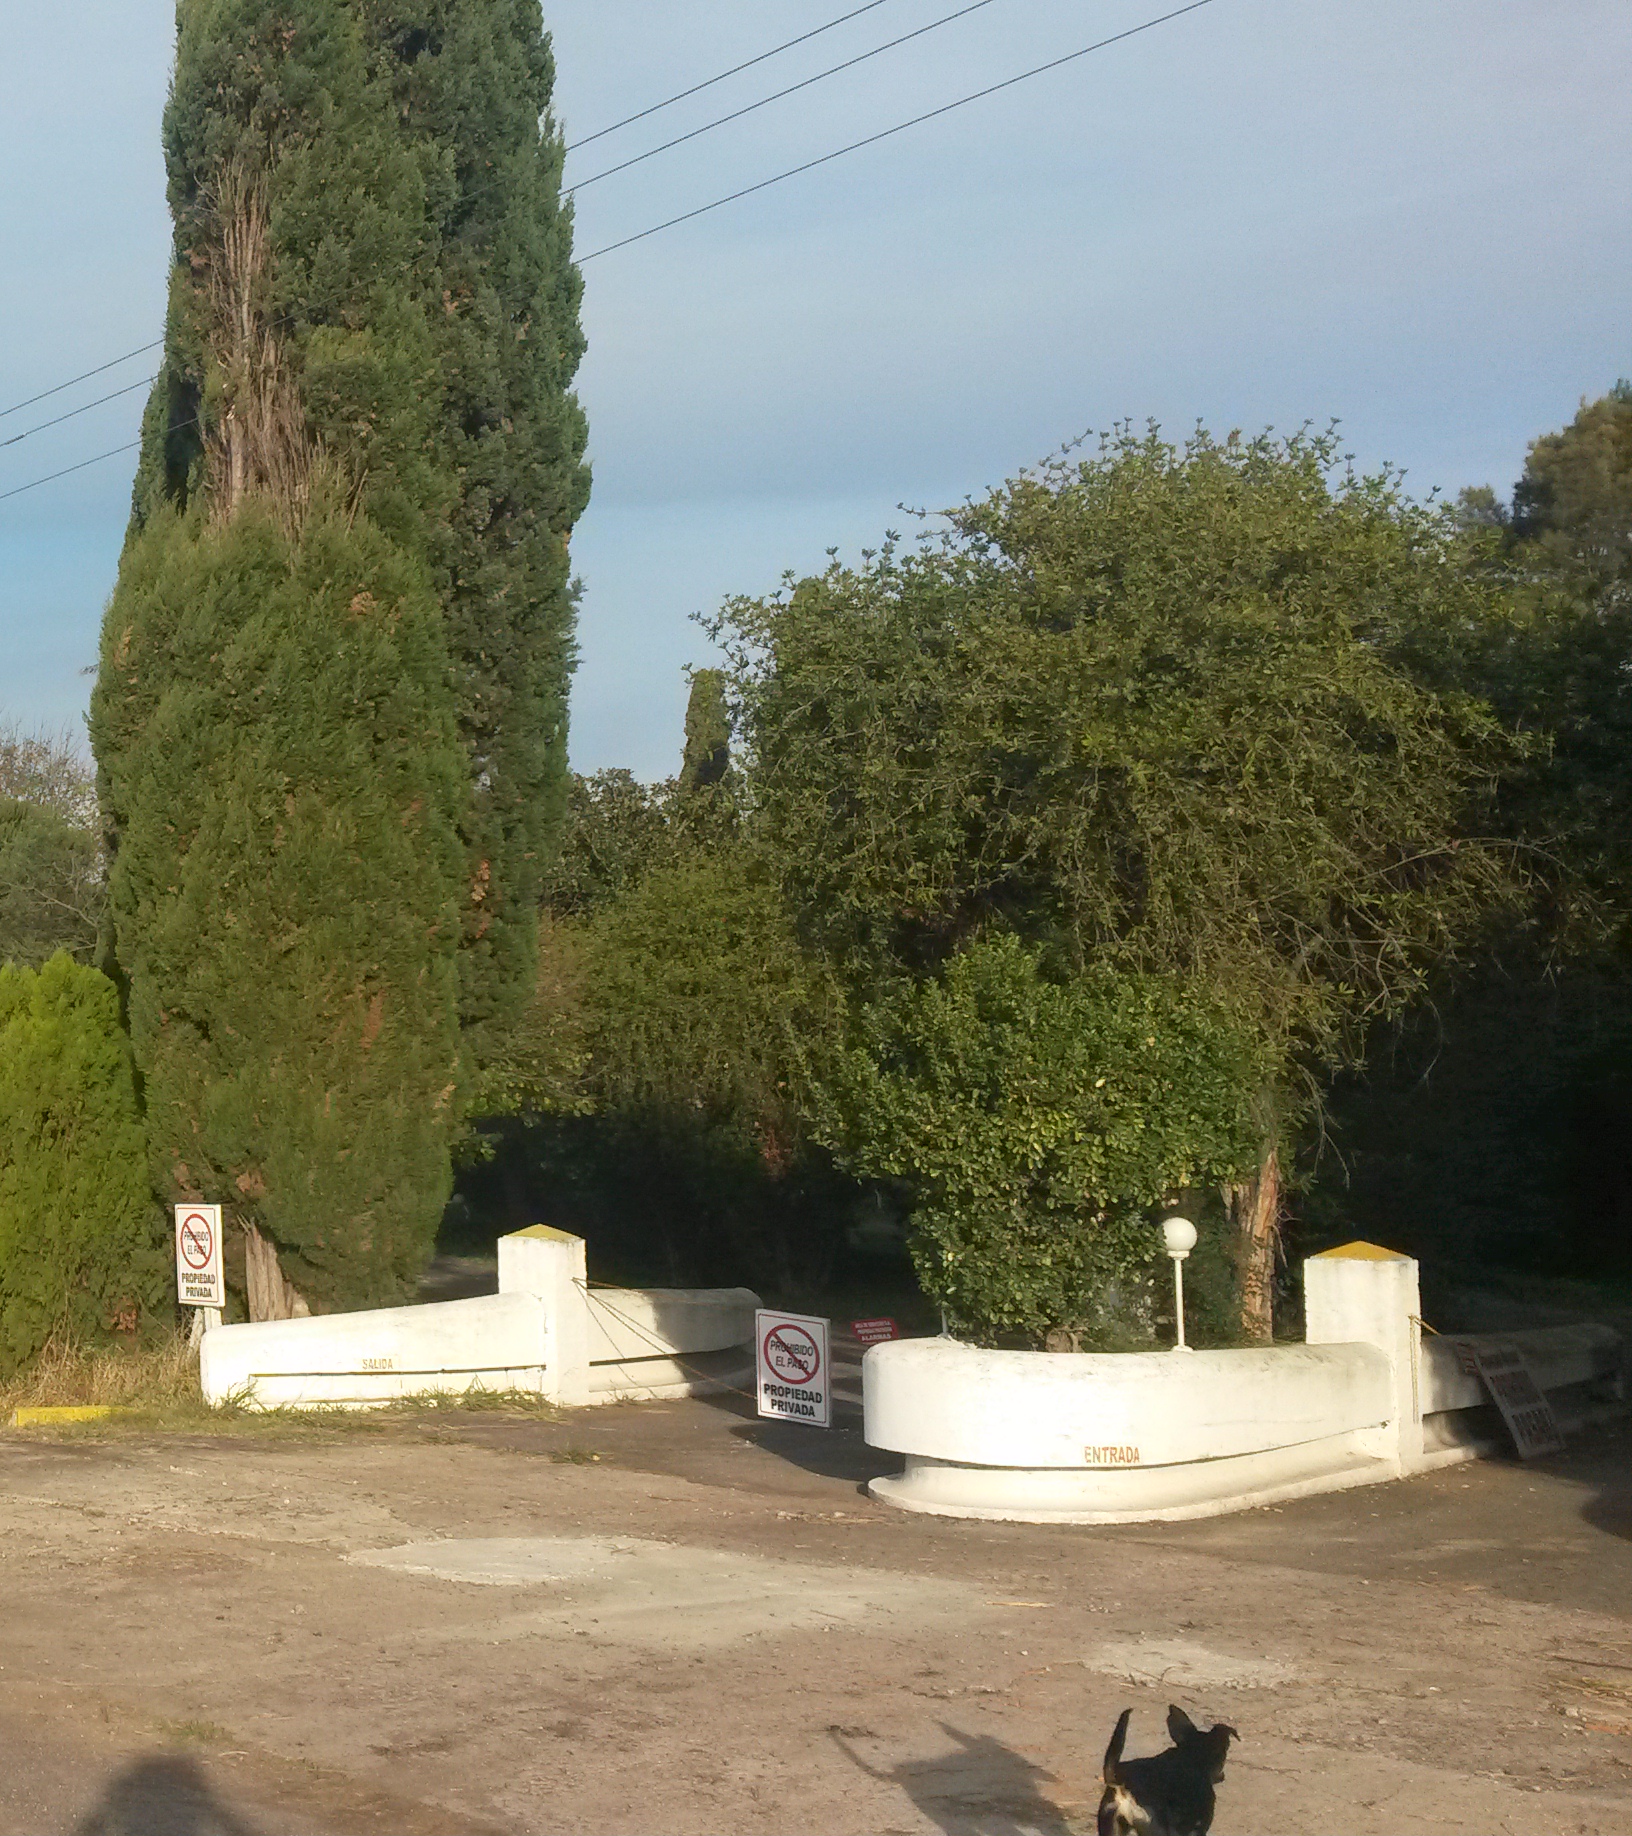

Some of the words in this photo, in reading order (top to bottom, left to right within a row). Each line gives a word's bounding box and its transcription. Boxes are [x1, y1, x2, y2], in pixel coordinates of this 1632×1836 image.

[187, 1245, 193, 1255] EL
[194, 1245, 206, 1255] PAO
[182, 1273, 215, 1284] PROPIEDAD
[186, 1286, 212, 1298] PRIVADA
[362, 1358, 394, 1370] SALIDA
[775, 1355, 785, 1368] EL
[787, 1357, 809, 1371] PAO
[764, 1384, 822, 1403] PROPIEDAD
[771, 1399, 815, 1417] PRIVADA
[1084, 1446, 1140, 1463] ENTRADA
